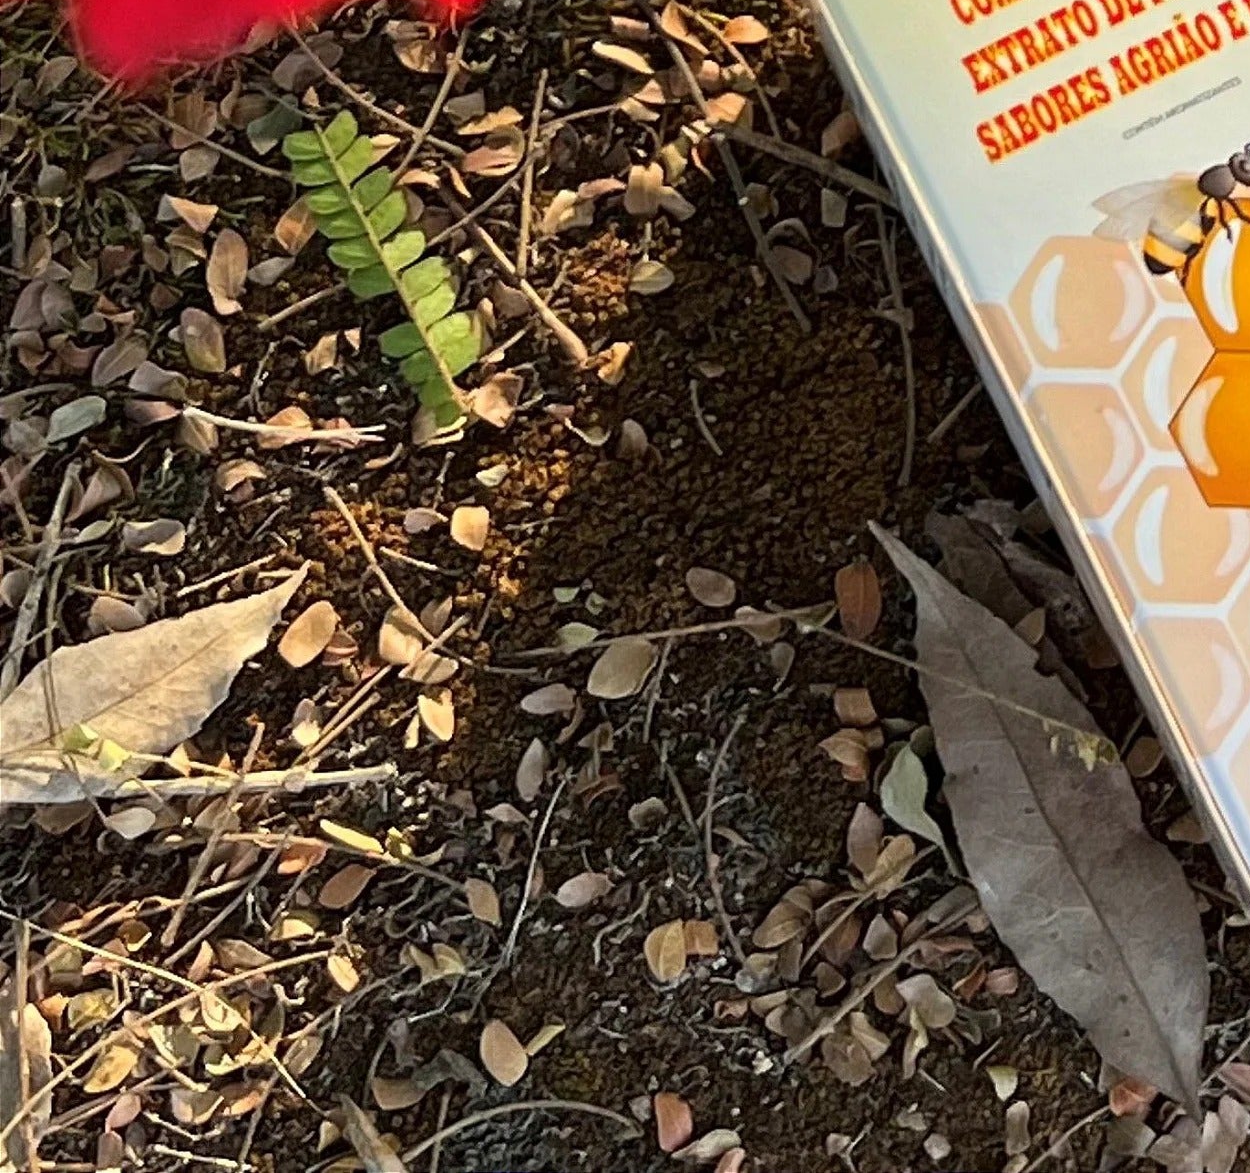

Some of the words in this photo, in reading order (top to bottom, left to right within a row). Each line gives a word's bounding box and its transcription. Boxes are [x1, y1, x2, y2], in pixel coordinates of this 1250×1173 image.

[976, 65, 1112, 164] SABORES
[1108, 12, 1222, 95] AGRIÃO
[1217, 0, 1249, 41] E
